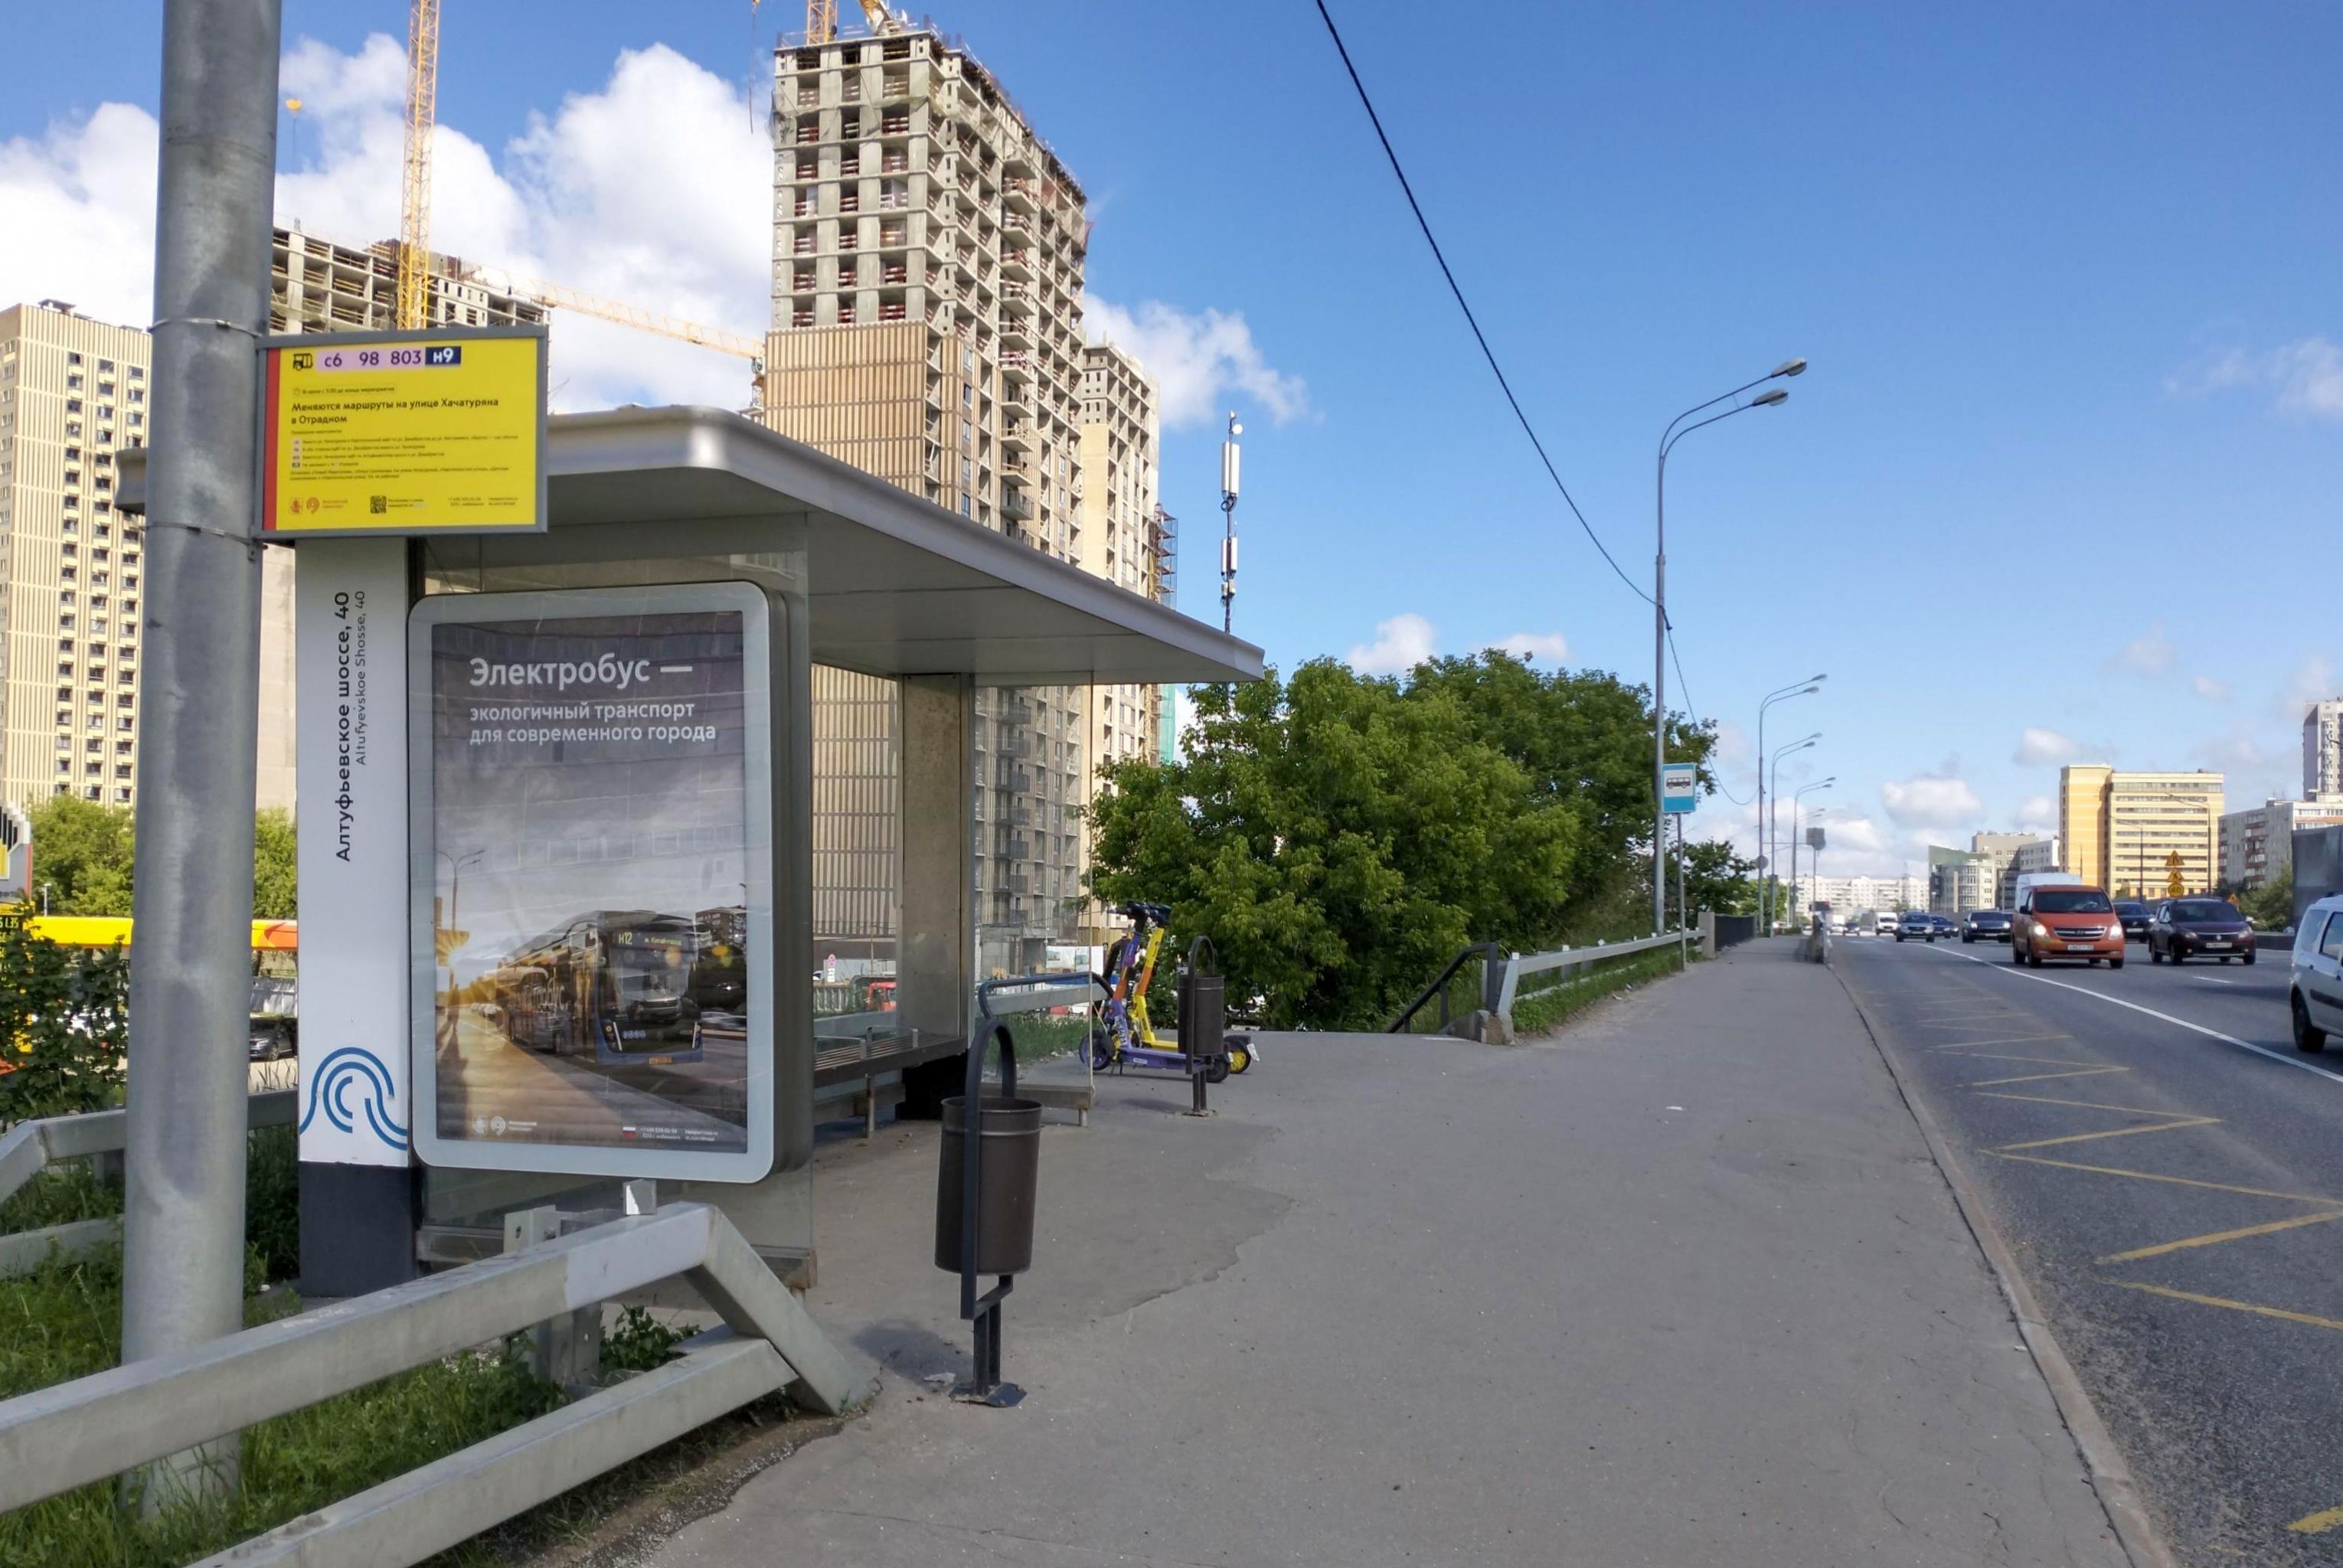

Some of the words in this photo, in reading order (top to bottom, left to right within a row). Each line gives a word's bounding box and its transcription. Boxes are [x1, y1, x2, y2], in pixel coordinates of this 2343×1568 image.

[359, 351, 379, 366] 98
[390, 350, 420, 364] 803
[292, 403, 341, 411] Меняются
[343, 401, 394, 411] маршруты
[410, 400, 438, 410] улице
[441, 398, 498, 409] Хачатуряна
[299, 414, 348, 425] Отрадном
[335, 592, 348, 619] 40
[355, 591, 365, 609] 40
[355, 613, 367, 667] Shosse,
[338, 626, 352, 697] шоссе,
[469, 652, 650, 691] Электробус
[355, 671, 368, 766] Altufyevskoe
[470, 701, 590, 721] экологичный
[594, 704, 694, 722] транспорт
[469, 729, 502, 746] для
[508, 727, 642, 746] современного
[649, 726, 715, 743] города
[335, 704, 354, 862] Алтуфьевское
